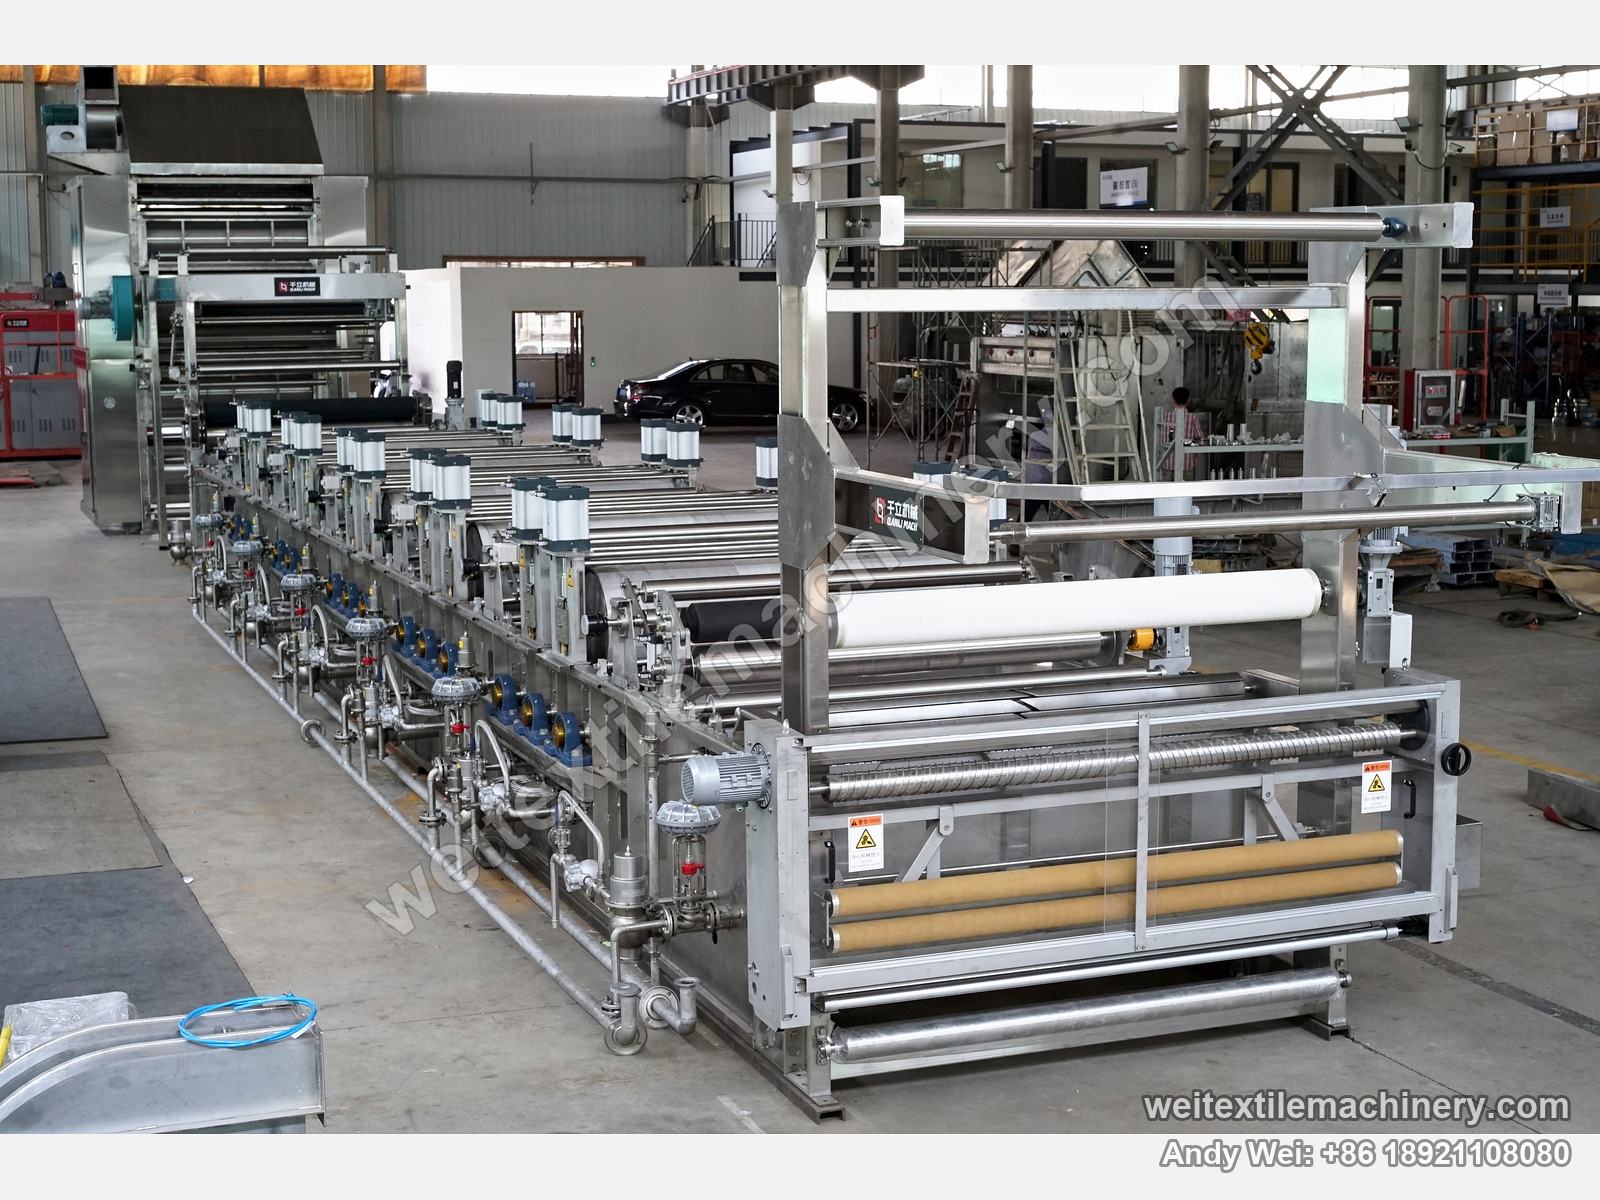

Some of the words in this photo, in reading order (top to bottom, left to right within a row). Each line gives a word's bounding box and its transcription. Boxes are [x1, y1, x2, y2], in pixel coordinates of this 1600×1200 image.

[887, 500, 918, 520] 千立机械
[903, 520, 918, 531] MACH
